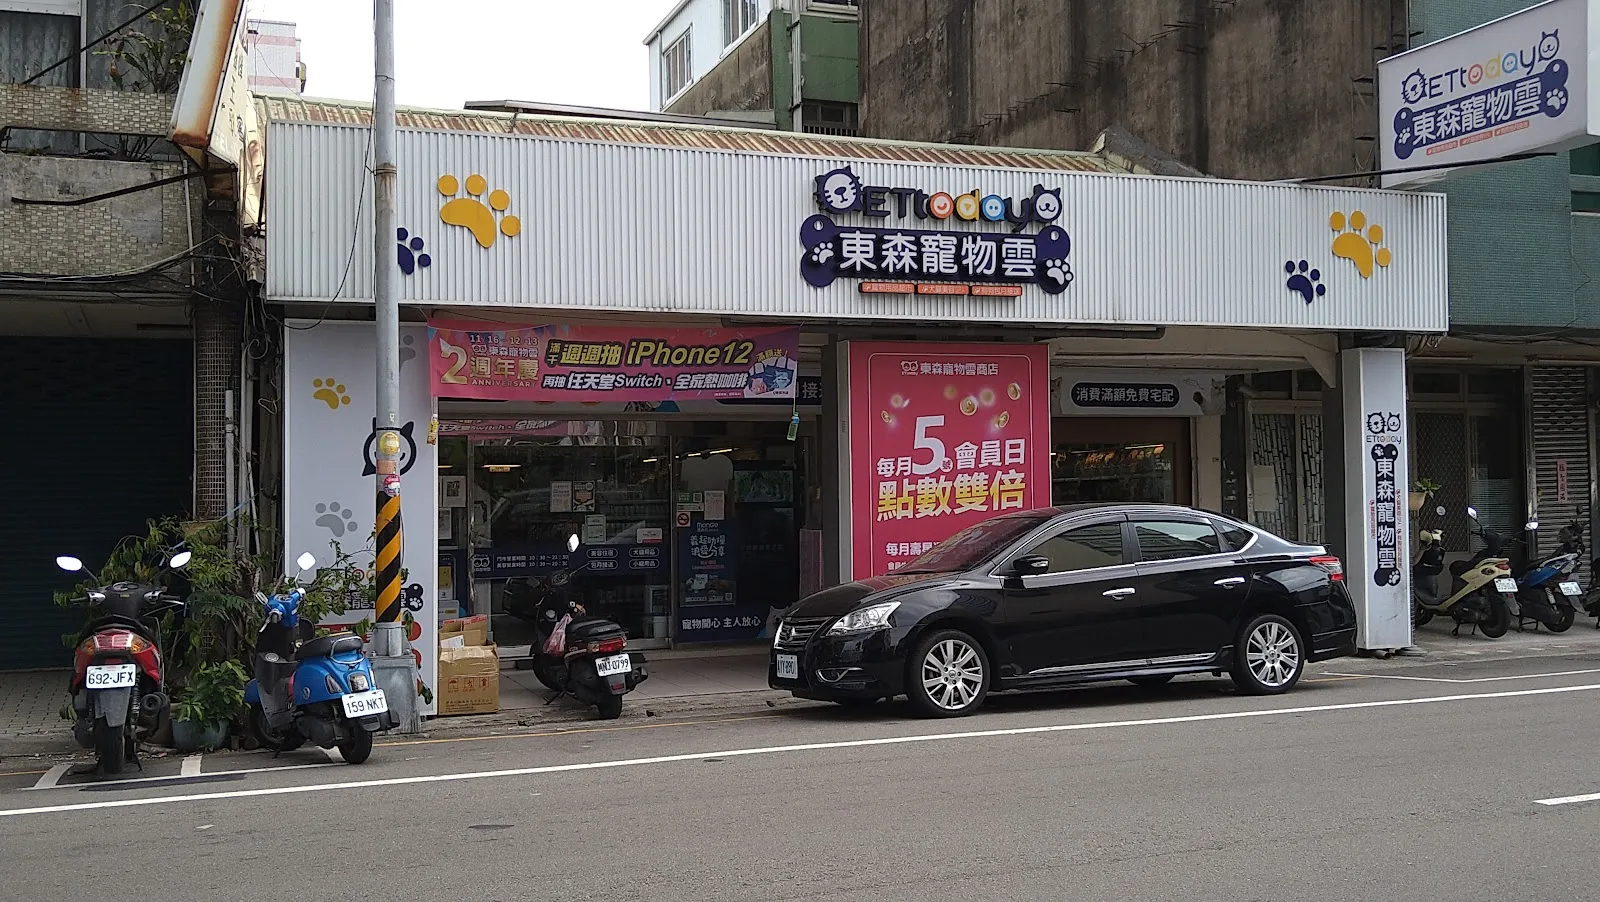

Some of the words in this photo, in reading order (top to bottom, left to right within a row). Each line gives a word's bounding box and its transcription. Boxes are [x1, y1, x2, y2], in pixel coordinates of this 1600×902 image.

[1429, 44, 1535, 99] ETtoday
[1412, 77, 1541, 146] 東森寵物雲
[863, 186, 1030, 233] ETtoday
[839, 230, 1037, 278] 東森寵物雲
[489, 346, 538, 357] 東森寵物雲
[920, 362, 999, 376] 東森寵物雲商店
[472, 379, 536, 388] ANNIVERSARY
[1076, 387, 1174, 402] 消費滿額免費宅配
[877, 469, 1026, 522] 點數雙倍
[1376, 457, 1396, 569] 東森寵物雲
[681, 617, 721, 630] 寵物開心
[722, 615, 761, 628] 主人放心
